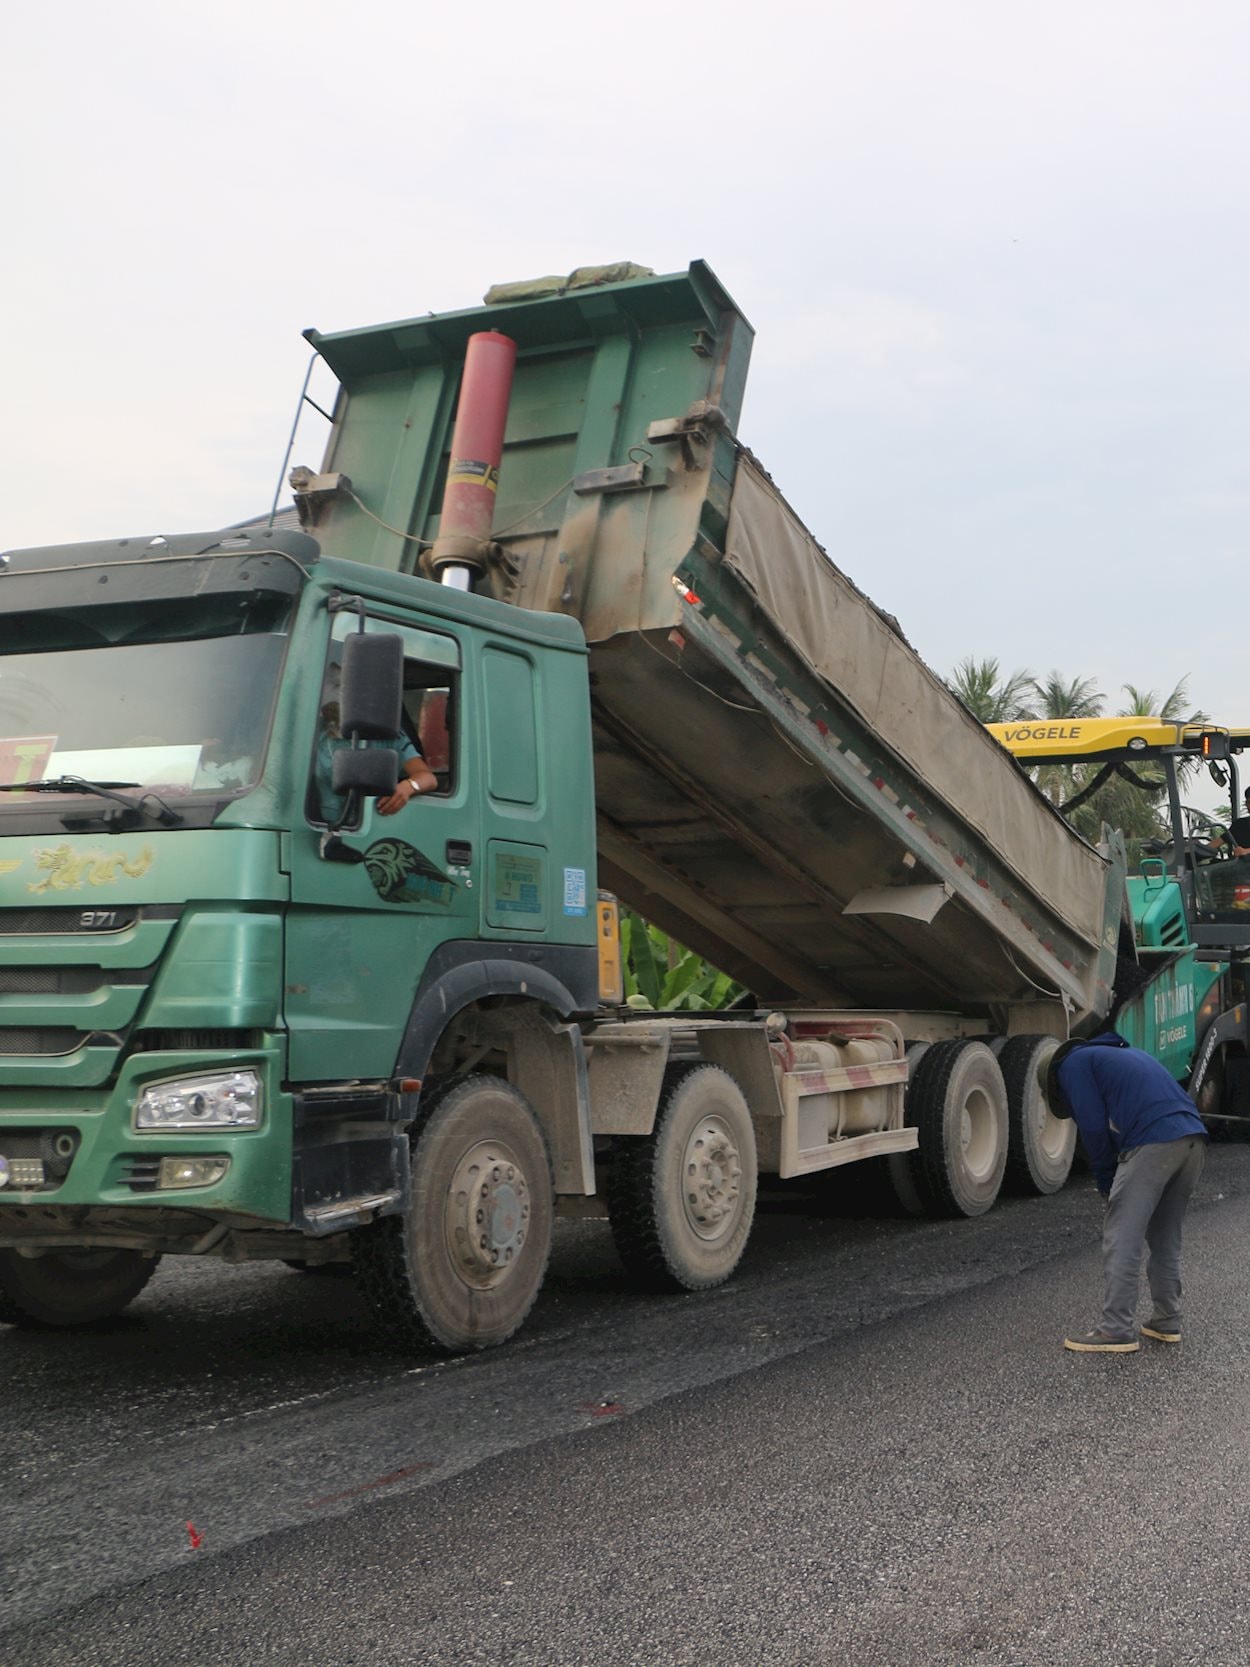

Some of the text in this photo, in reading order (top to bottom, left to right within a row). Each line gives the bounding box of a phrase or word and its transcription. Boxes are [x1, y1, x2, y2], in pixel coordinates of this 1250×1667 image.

[1004, 726, 1081, 742] VÖGELE
[80, 911, 117, 926] 371
[1166, 1025, 1187, 1043] VÖGELE
